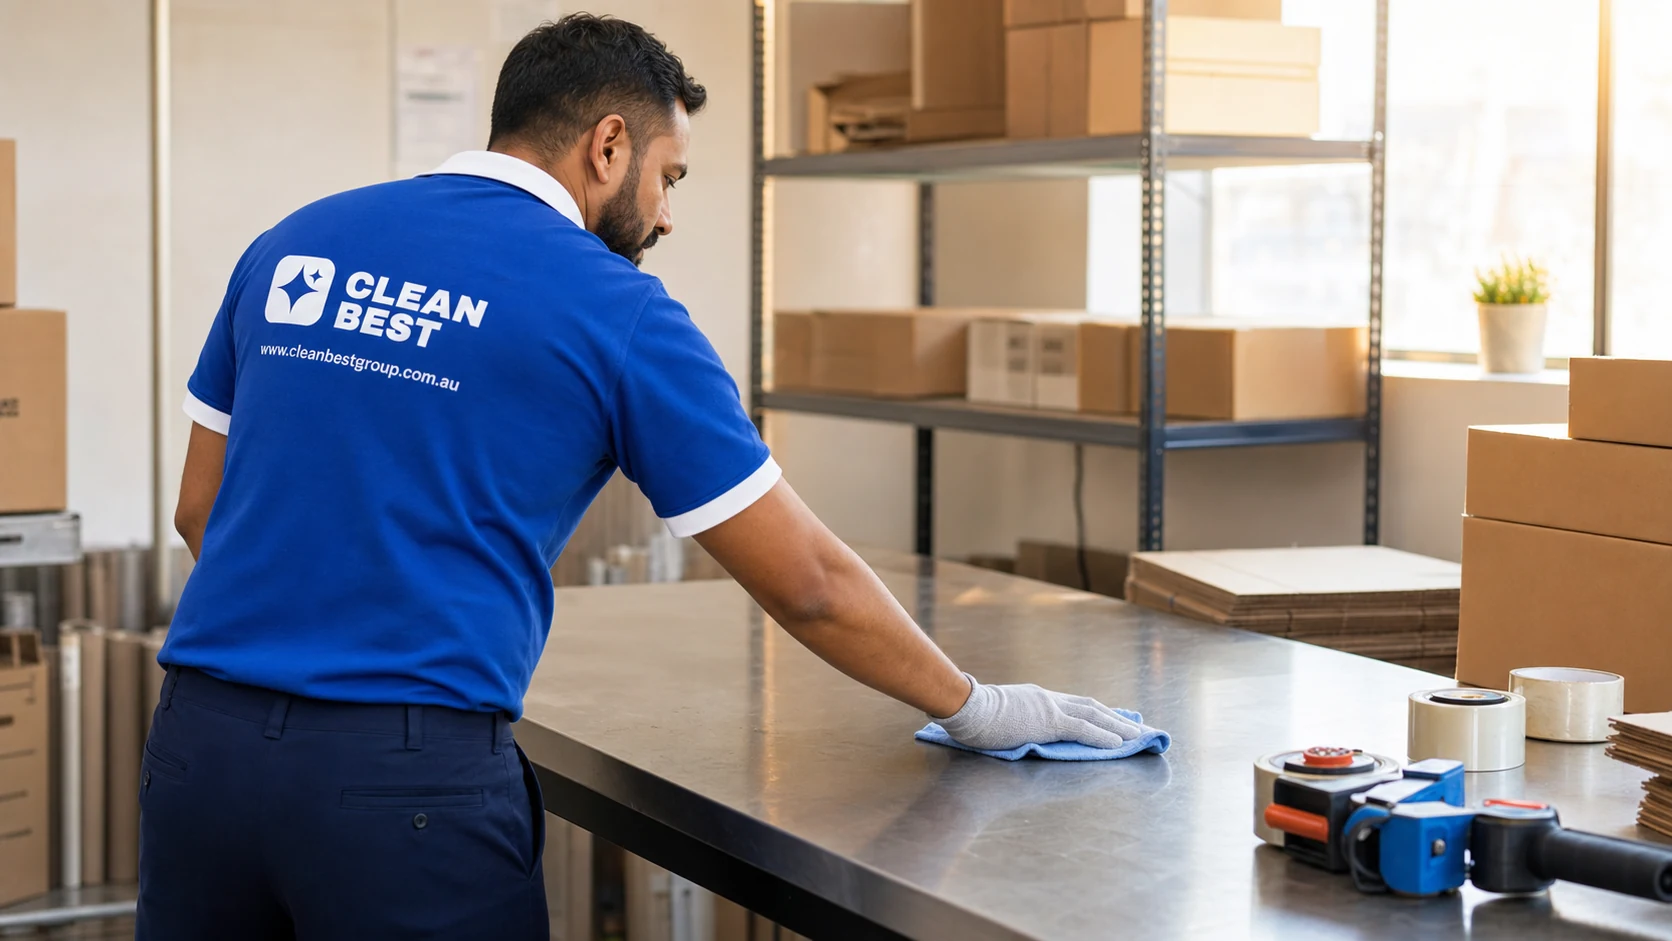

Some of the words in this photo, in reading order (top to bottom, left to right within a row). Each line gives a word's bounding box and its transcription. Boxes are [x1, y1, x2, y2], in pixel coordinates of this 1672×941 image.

[345, 271, 488, 328] CLEAN
[333, 301, 442, 348] BEST
[260, 344, 460, 392] www.cleanbestgroup.com.au
